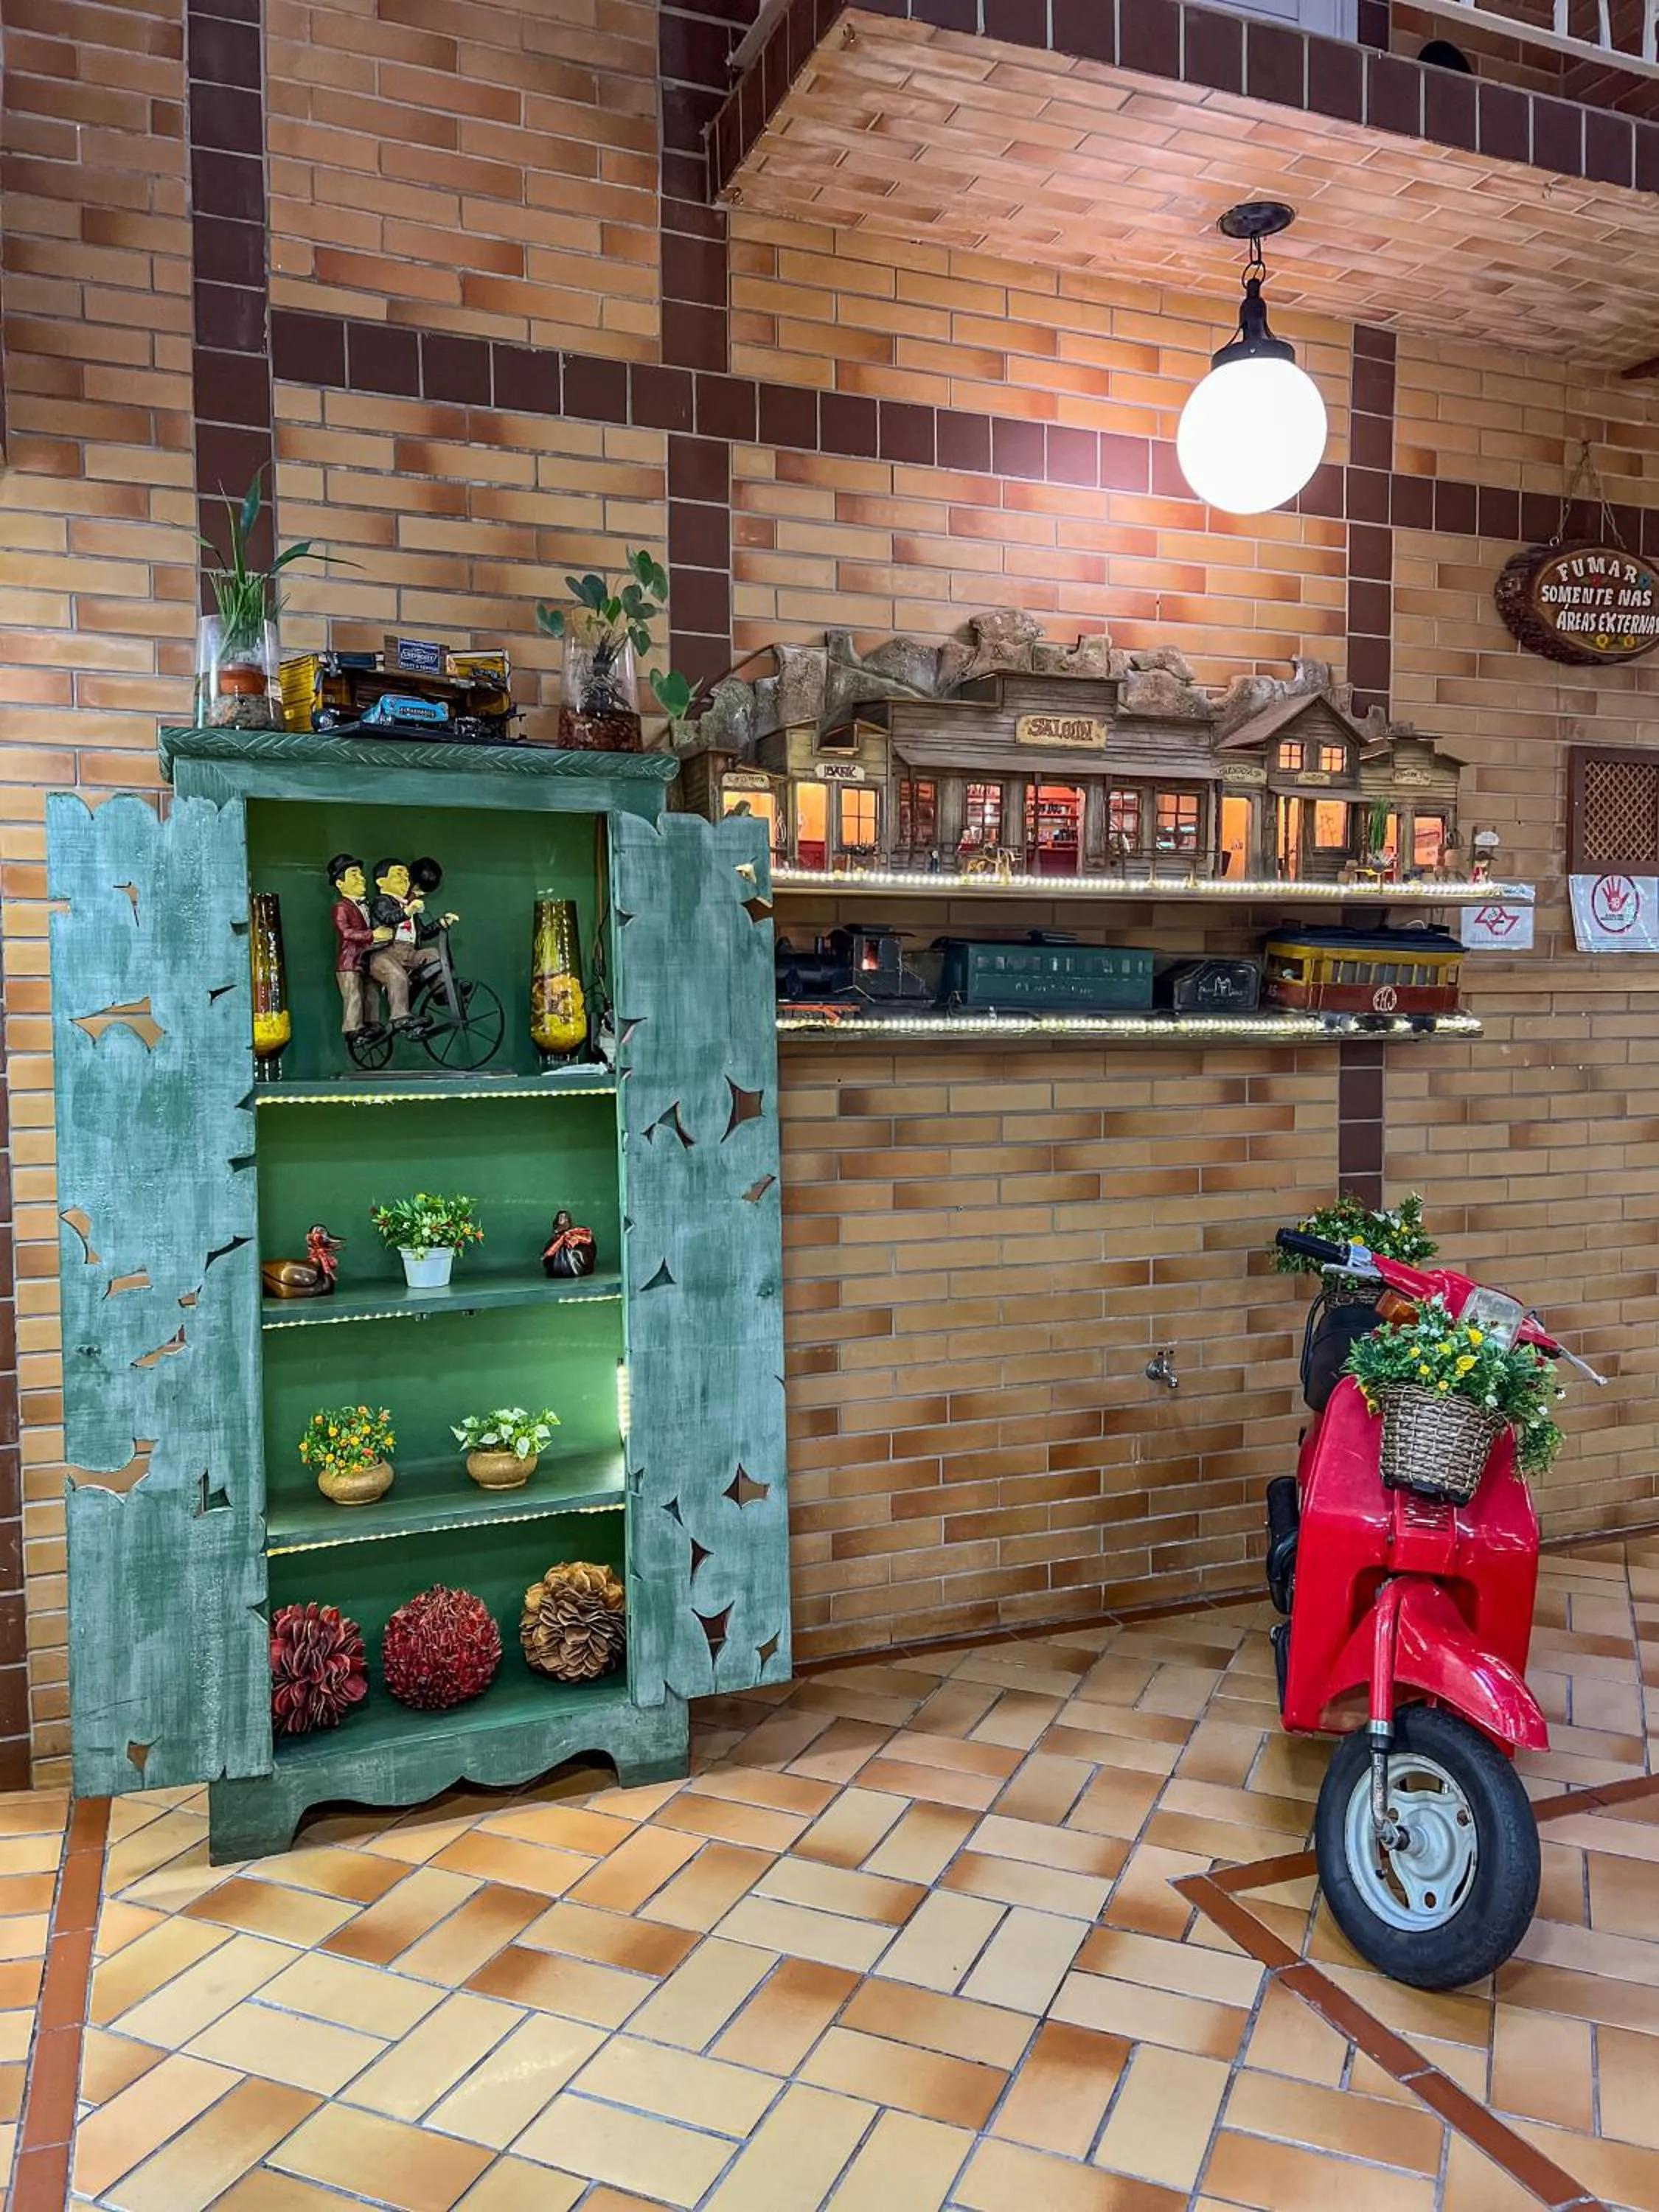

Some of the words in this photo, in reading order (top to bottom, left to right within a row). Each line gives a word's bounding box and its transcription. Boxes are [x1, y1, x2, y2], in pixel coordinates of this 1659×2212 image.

[1556, 556, 1638, 583] FUMAR
[1542, 585, 1613, 605] SOMENTE
[1618, 589, 1652, 607] NAS
[1557, 604, 1596, 632] ÁREAS
[1028, 717, 1093, 741] SALOON
[824, 765, 858, 778] BANK
